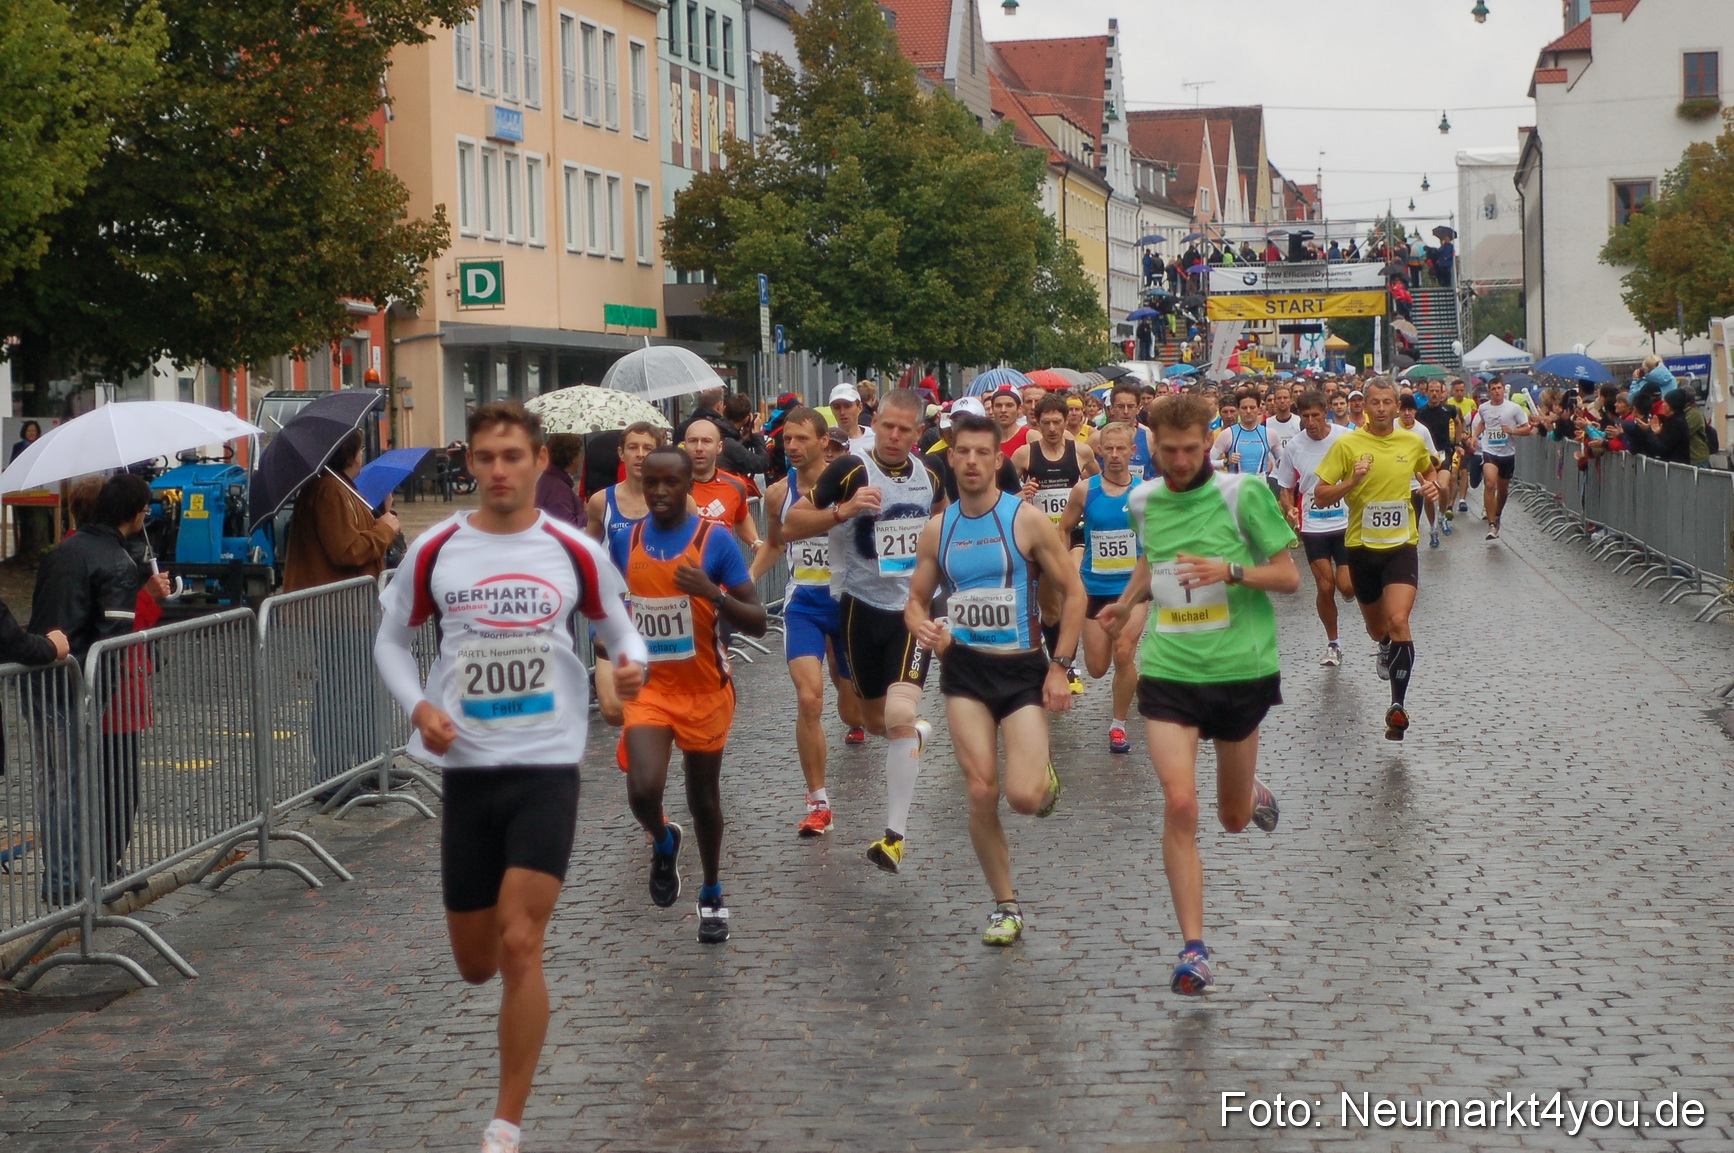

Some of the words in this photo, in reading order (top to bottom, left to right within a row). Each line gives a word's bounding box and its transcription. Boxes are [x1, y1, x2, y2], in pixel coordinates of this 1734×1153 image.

[466, 268, 496, 299] D
[1265, 299, 1326, 315] START
[1489, 431, 1506, 440] 2166
[1373, 511, 1401, 527] 539
[1099, 541, 1128, 557] 555
[445, 587, 539, 604] GERHART
[448, 604, 487, 613] Autohaus
[954, 604, 1010, 627] 2000
[1171, 610, 1209, 623] Michael
[636, 612, 684, 637] 2001
[457, 649, 487, 658] PARTL
[490, 646, 537, 657] Neumarkt
[645, 643, 677, 653] achary
[465, 658, 545, 695] 2002
[492, 701, 523, 716] Felix
